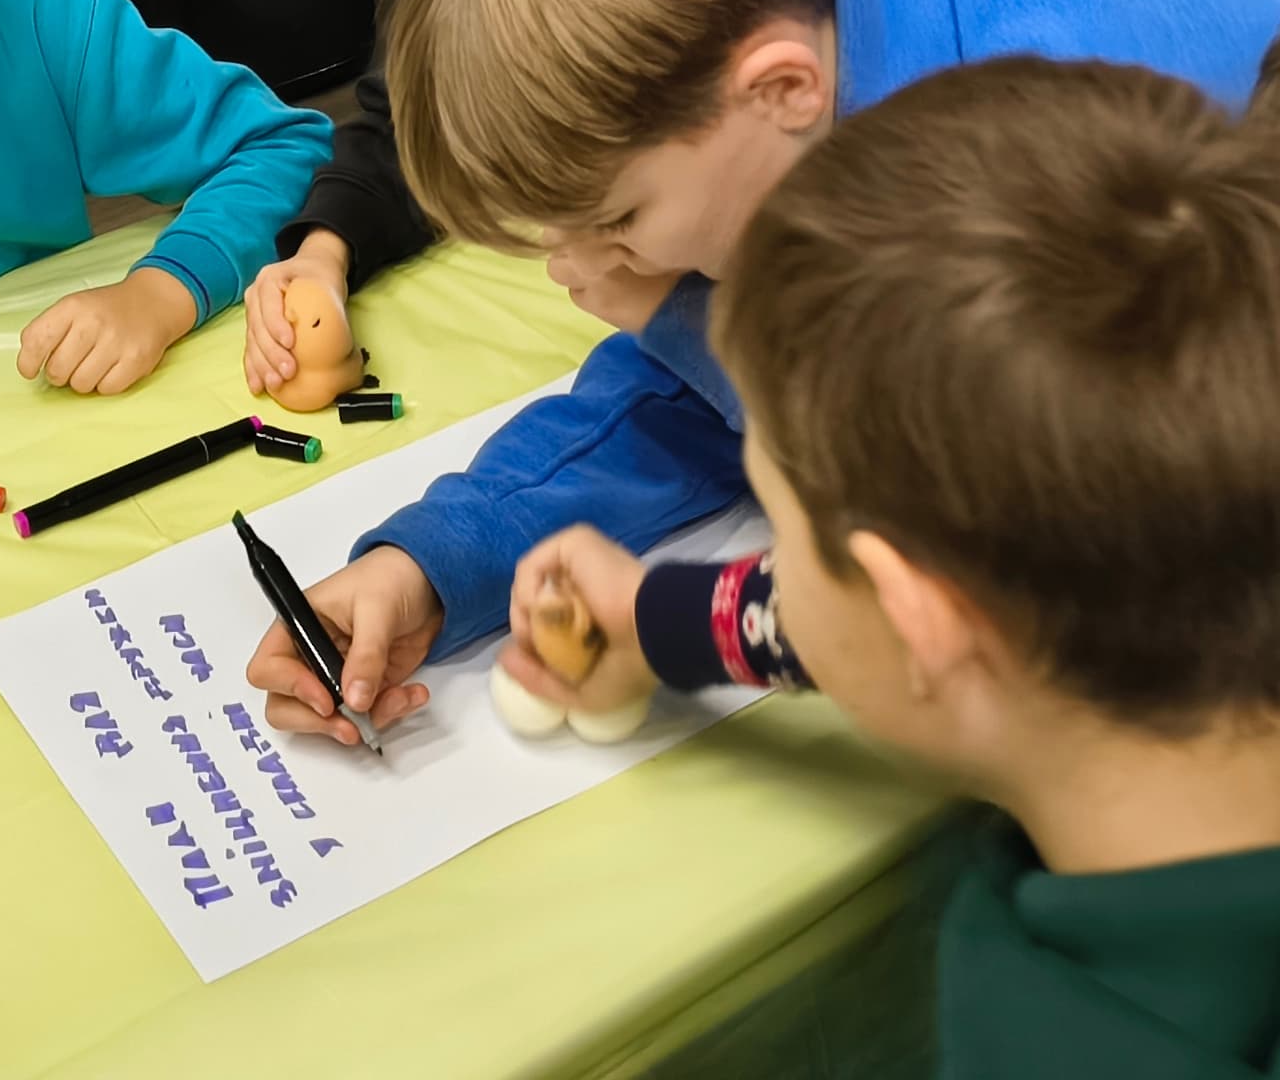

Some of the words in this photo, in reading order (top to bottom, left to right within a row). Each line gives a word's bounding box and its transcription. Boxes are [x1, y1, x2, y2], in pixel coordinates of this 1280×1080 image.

[158, 614, 214, 684] ЧАСИ
[70, 690, 134, 760] ДЛЯ
[146, 800, 234, 910] ПЛАН
